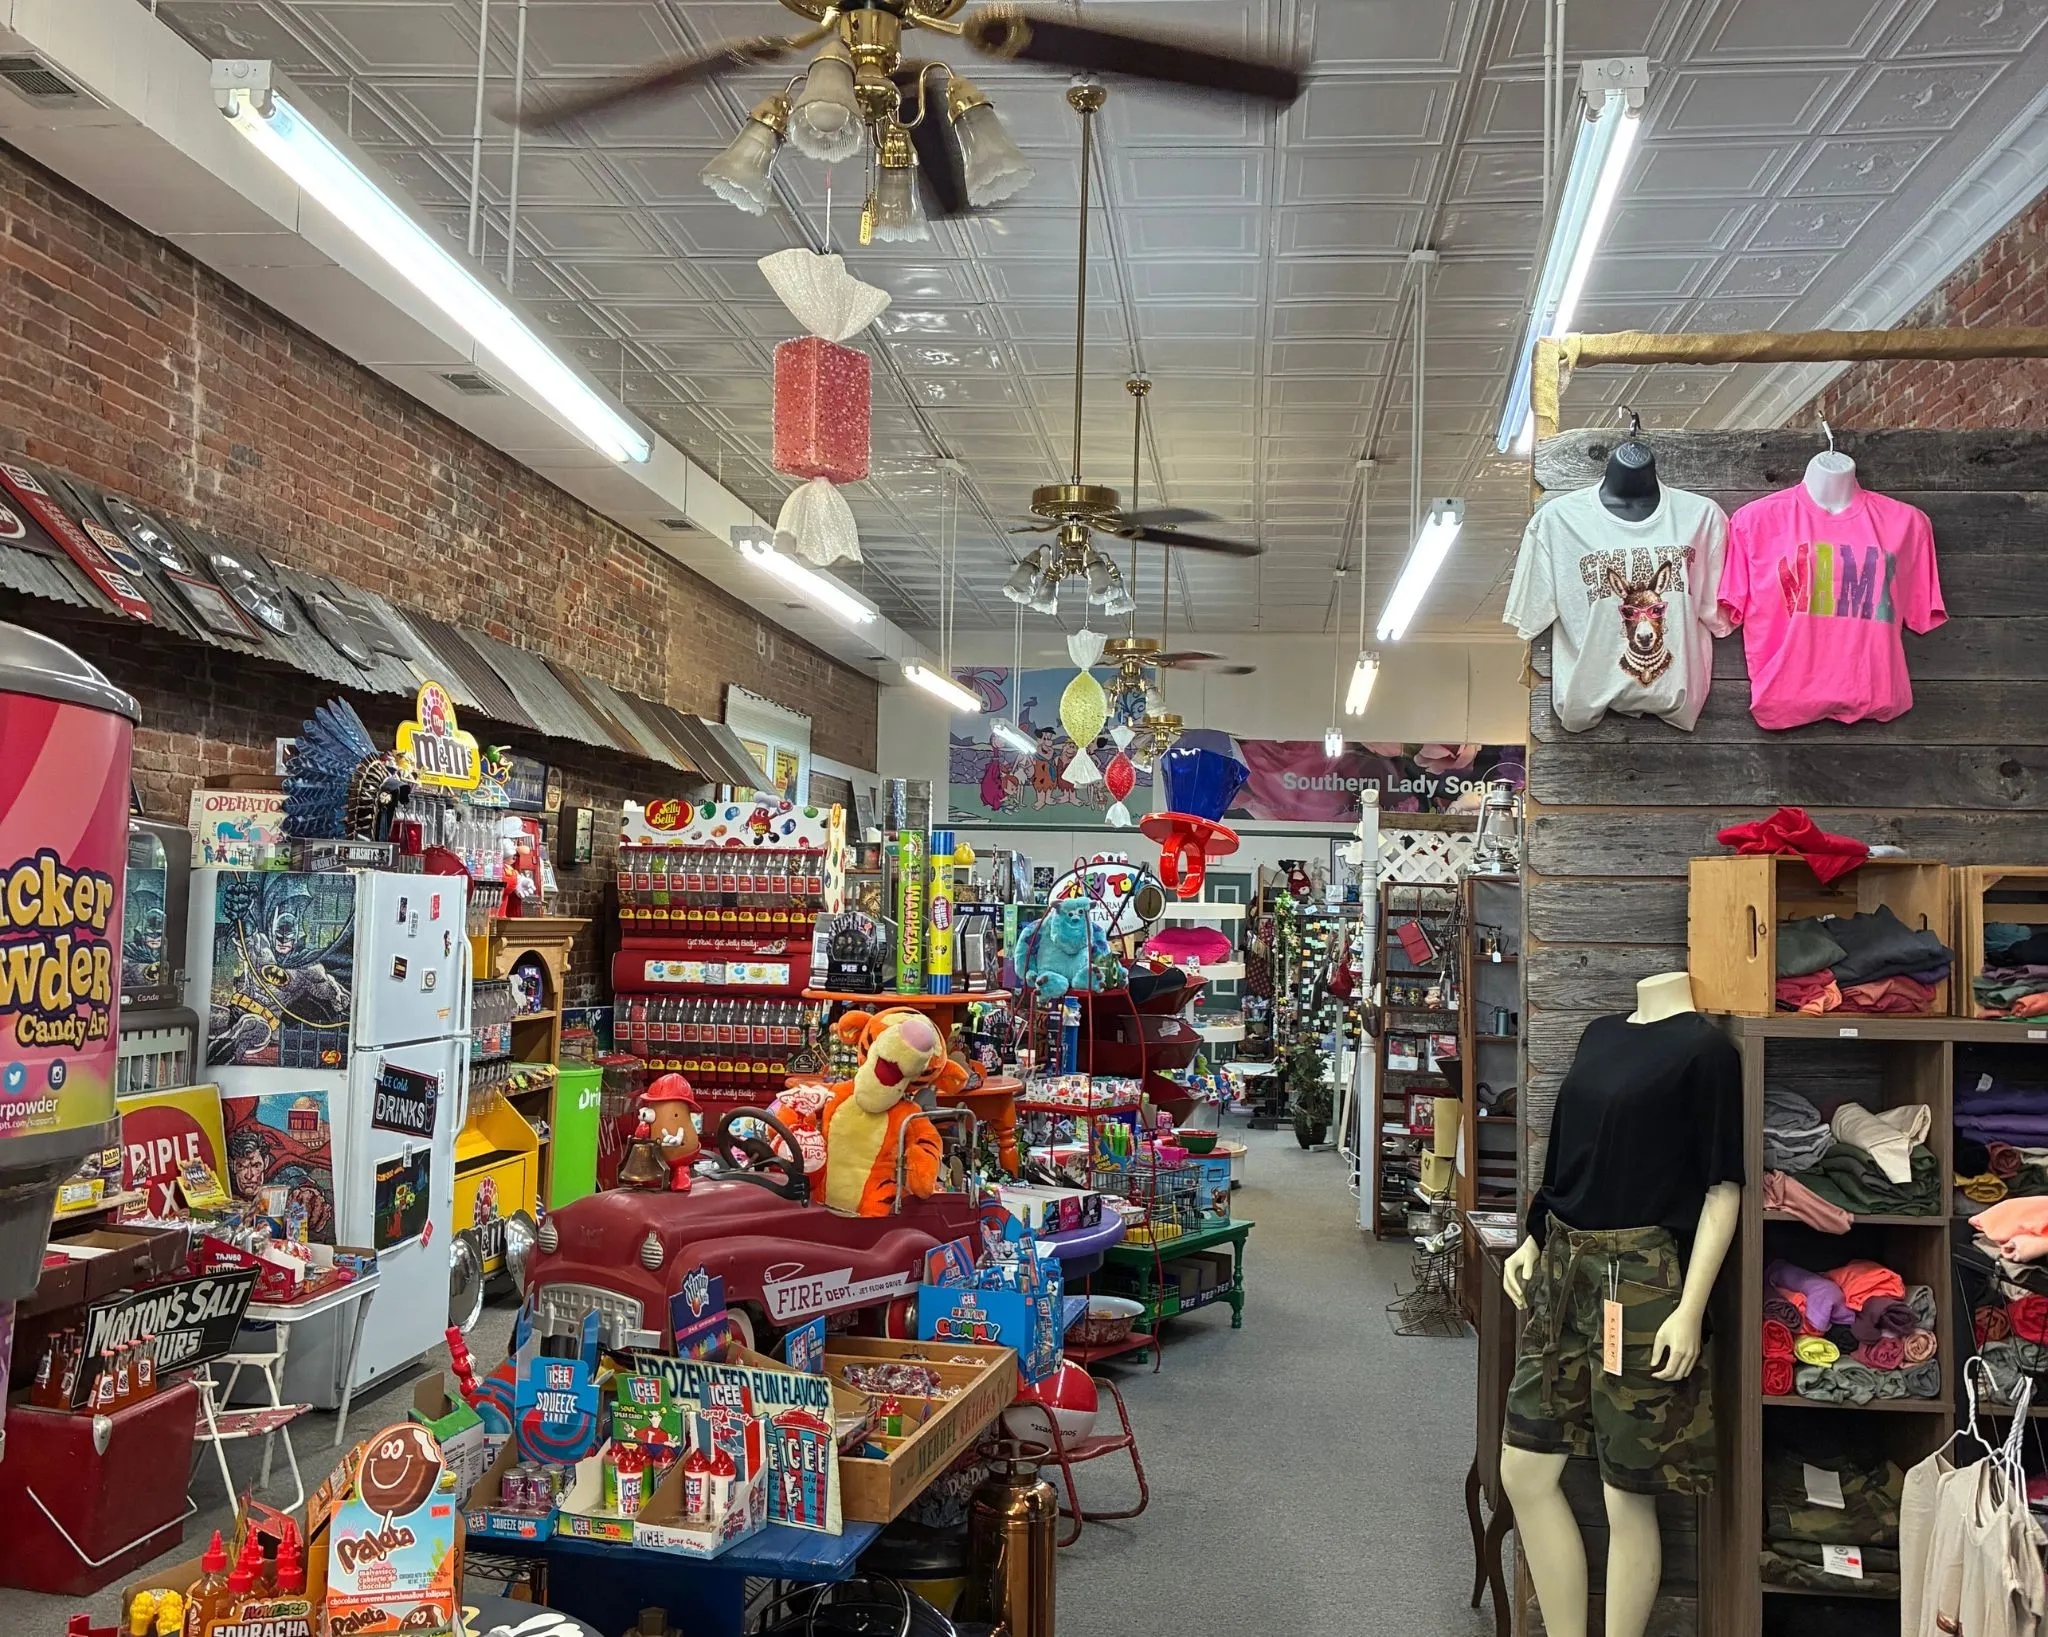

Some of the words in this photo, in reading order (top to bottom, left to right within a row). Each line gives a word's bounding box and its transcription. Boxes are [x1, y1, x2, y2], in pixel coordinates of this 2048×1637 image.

[1579, 545, 1696, 605] SMART
[1283, 772, 1380, 792] Southern
[1388, 774, 1438, 798] Lady
[205, 796, 283, 814] OPERATIO
[660, 801, 681, 815] Jelly
[651, 813, 677, 826] Belly
[350, 848, 380, 861] HERSHEY'S
[903, 885, 922, 965] WARHEADS
[841, 964, 857, 972] PEZ
[18, 1014, 87, 1049] Candy
[88, 1010, 109, 1040] Art
[393, 1077, 408, 1092] Cold
[376, 1093, 425, 1128] DRINKS
[123, 1132, 199, 1179] RIPLE
[777, 1281, 823, 1314] FIRE
[825, 1286, 855, 1301] DEPT.
[1181, 1298, 1196, 1309] PEZ
[88, 1287, 187, 1358] MORTON'S
[185, 1281, 252, 1324] SALT
[936, 1318, 1000, 1341] GUMMY
[154, 1332, 200, 1368] OURS
[548, 1369, 570, 1385] ICEE
[632, 1382, 660, 1399] ICEE
[709, 1384, 744, 1407] ICEE
[753, 1371, 779, 1403] FUN
[782, 1373, 829, 1408] FLAVORS
[535, 1392, 578, 1414] SQUEEZE
[544, 1413, 569, 1424] CANDY
[701, 1408, 724, 1421] Spray
[725, 1408, 753, 1425] Candy
[779, 1437, 827, 1475] ICEE
[623, 1481, 641, 1496] ICEE
[468, 1515, 485, 1530] ICEE
[492, 1517, 517, 1531] SQUEEZE
[573, 1521, 591, 1533] ICEE
[641, 1531, 665, 1548] ICEE
[337, 1527, 415, 1574] Paleta
[358, 1582, 391, 1590] chocolate
[330, 1596, 359, 1606] chocolate
[361, 1594, 384, 1603] covered
[385, 1591, 424, 1600] marshmallow
[426, 1587, 450, 1599] lollipops
[330, 1607, 388, 1636] Paleta
